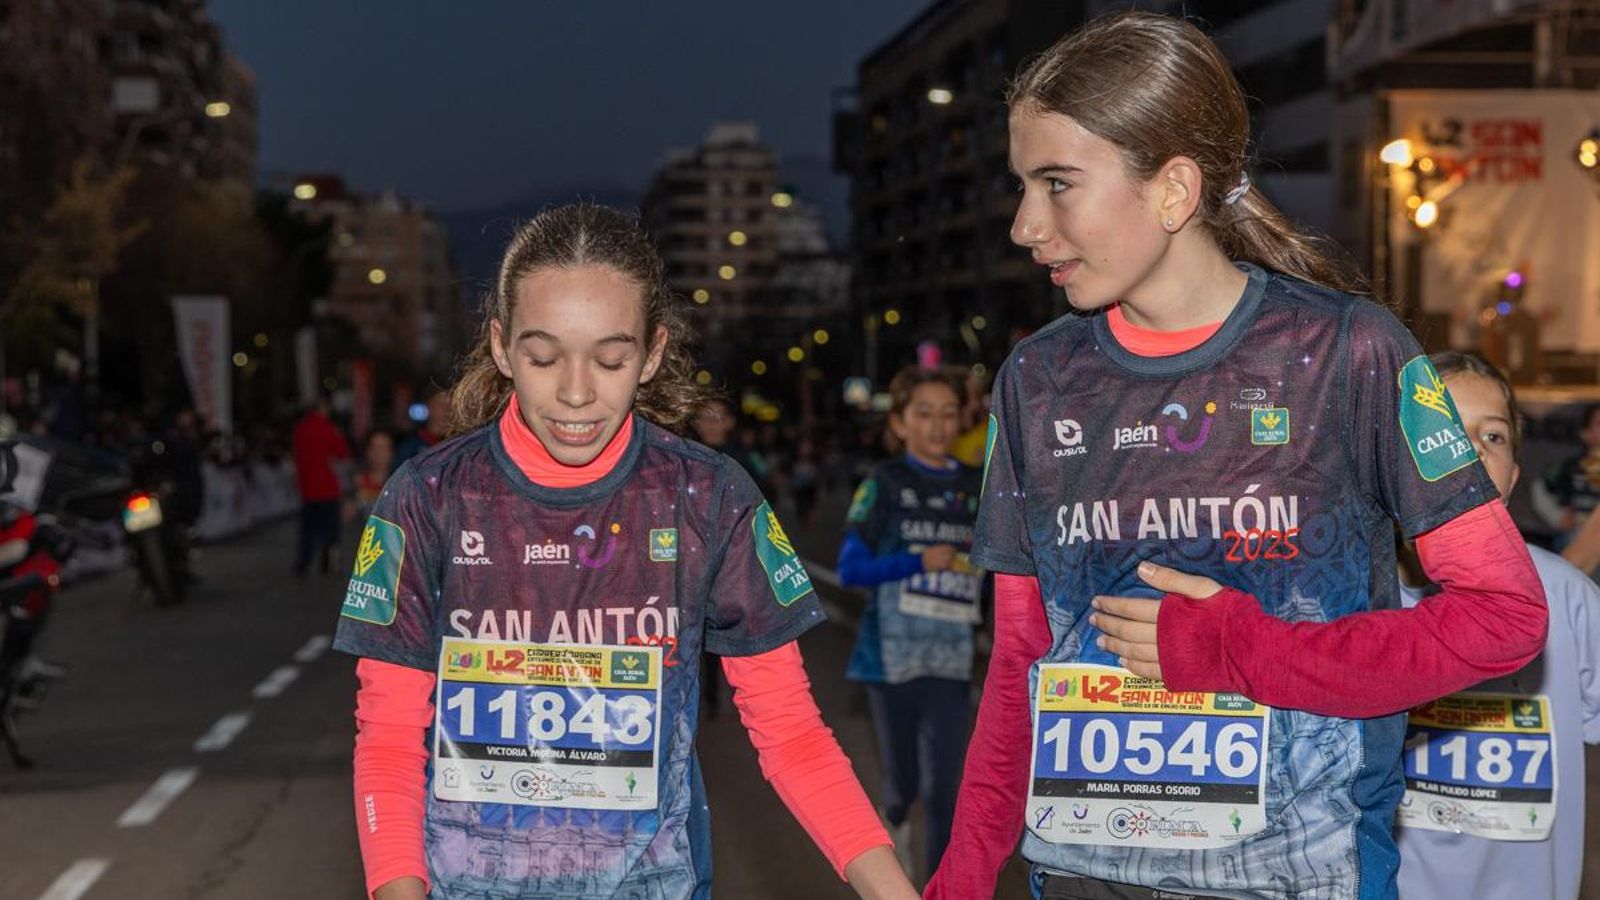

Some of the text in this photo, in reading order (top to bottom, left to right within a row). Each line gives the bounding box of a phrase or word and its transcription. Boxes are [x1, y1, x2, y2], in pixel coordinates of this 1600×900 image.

[1472, 119, 1543, 147] SAN
[1417, 428, 1458, 454] CAJA
[1057, 484, 1299, 546] SAN ANTÓN
[1223, 528, 1301, 562] 2025
[450, 608, 532, 641] SAN
[486, 649, 525, 677] 42
[1082, 674, 1122, 704] 42
[1121, 690, 1150, 703] SAN
[447, 687, 653, 745] 11843
[486, 746, 527, 758] VICTORIA
[568, 748, 607, 761] ÁLVARO
[1043, 718, 1259, 778] 10546
[1086, 782, 1201, 796] MARIA PORRAS OSORIO
[1416, 780, 1498, 799] PILAR PULIDO LÓPEZ
